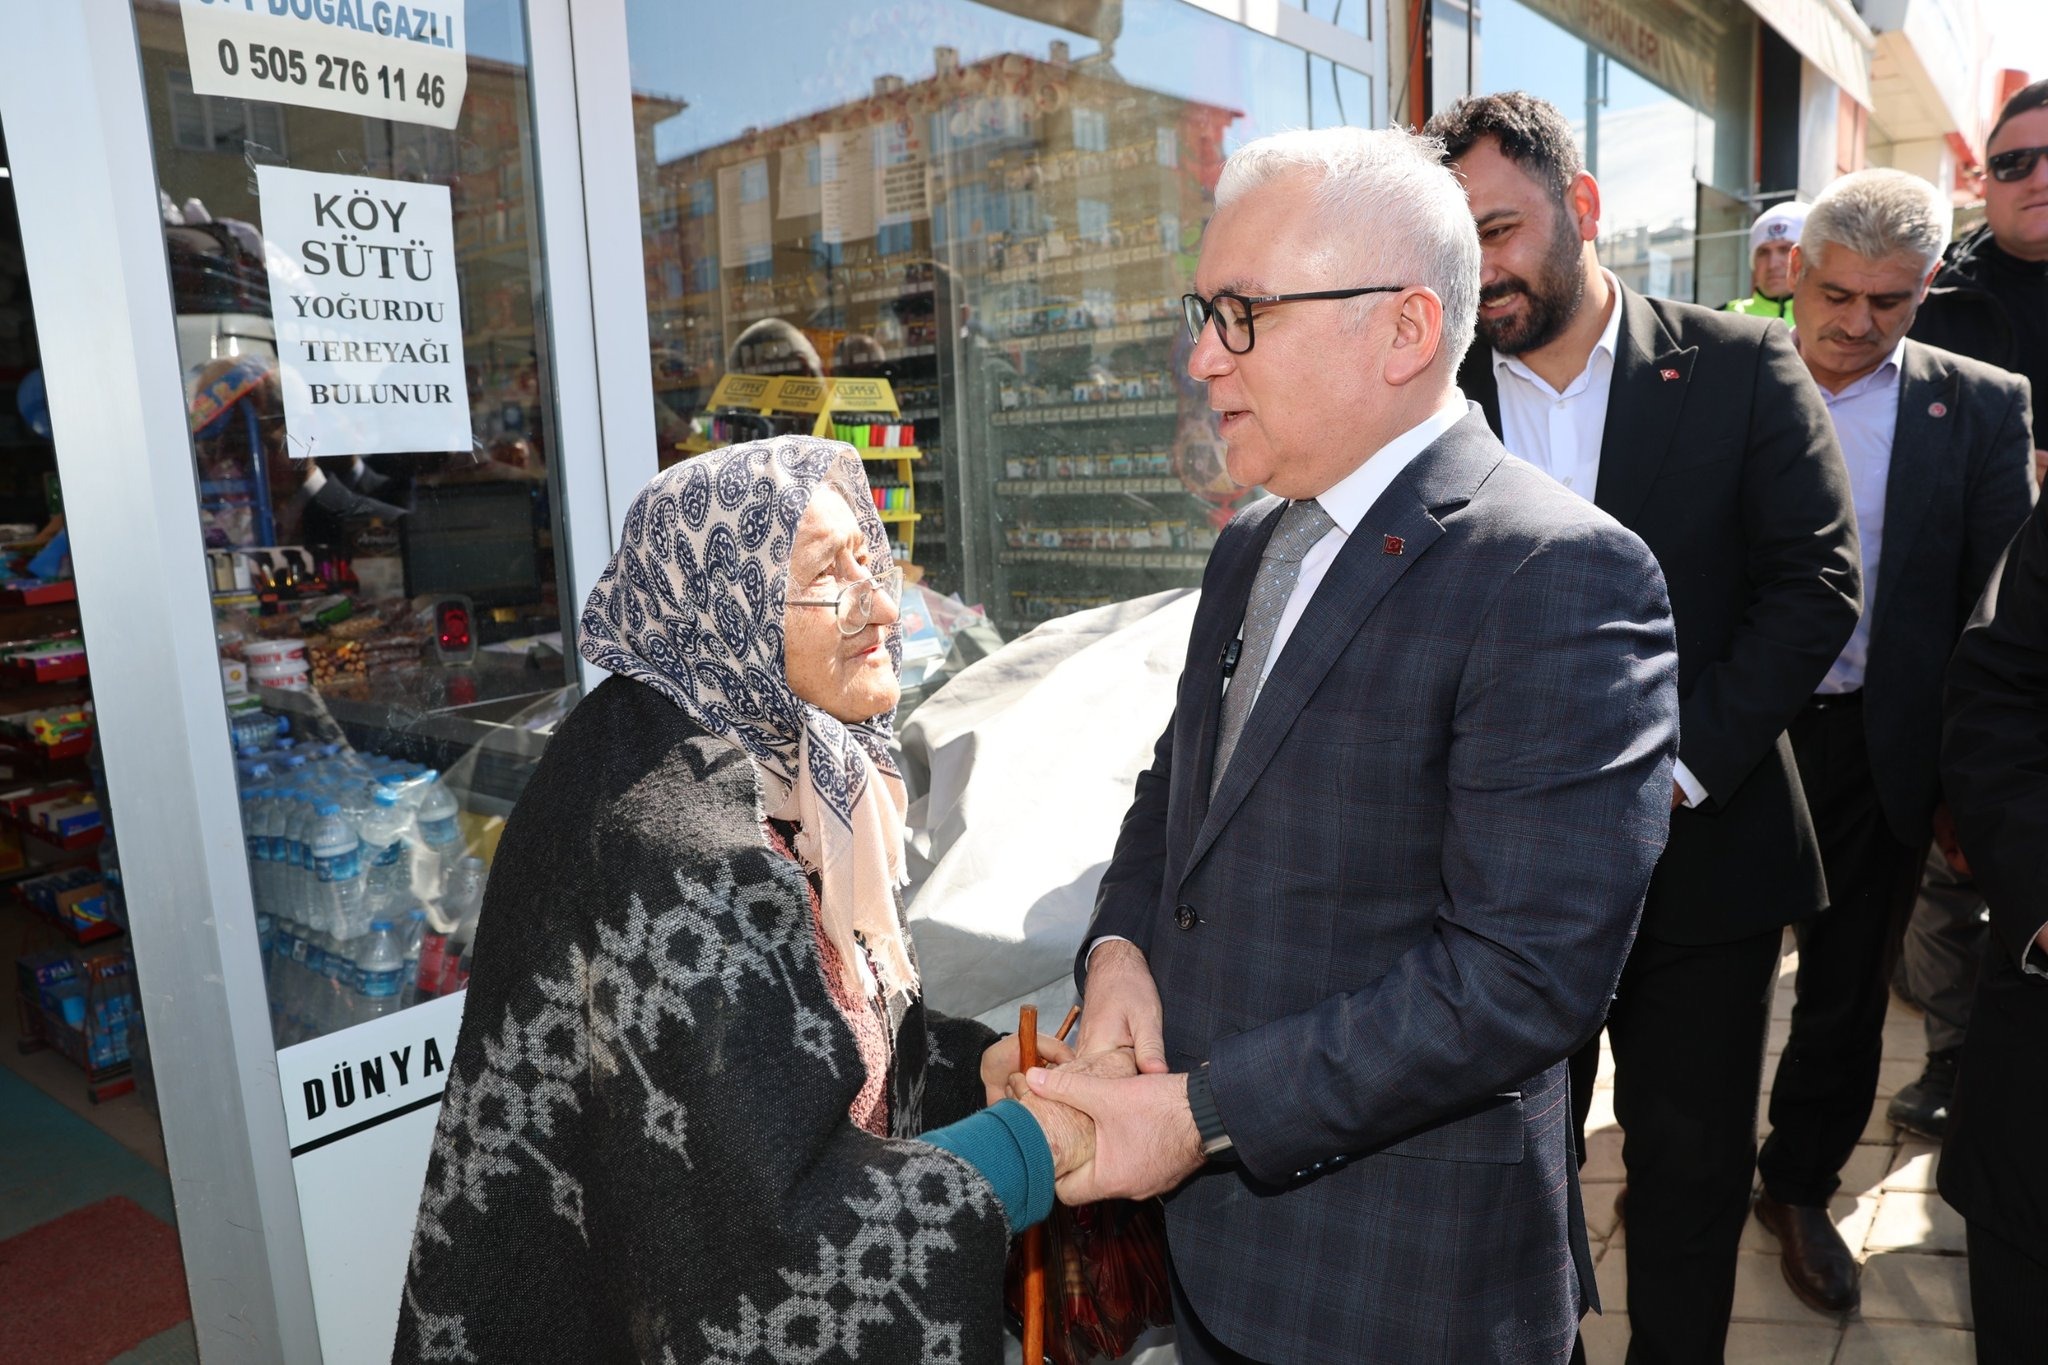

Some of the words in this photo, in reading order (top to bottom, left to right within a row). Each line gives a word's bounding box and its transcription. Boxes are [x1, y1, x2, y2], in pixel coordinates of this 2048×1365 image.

[217, 38, 240, 77] 0
[249, 42, 308, 86] 505
[314, 53, 369, 96] 276
[377, 64, 407, 102] 11
[416, 71, 445, 109] 46
[313, 188, 408, 234] KÖY
[301, 233, 434, 282] SÜTÜ
[289, 291, 445, 323] YOĞURDU
[299, 337, 451, 364] TEREYAĞI
[308, 383, 453, 406] BULUNUR
[727, 381, 765, 394] CLIPPER
[783, 383, 820, 397] CLIPPER
[836, 384, 877, 395] CLIPPER
[302, 1036, 444, 1121] DÜNYA
